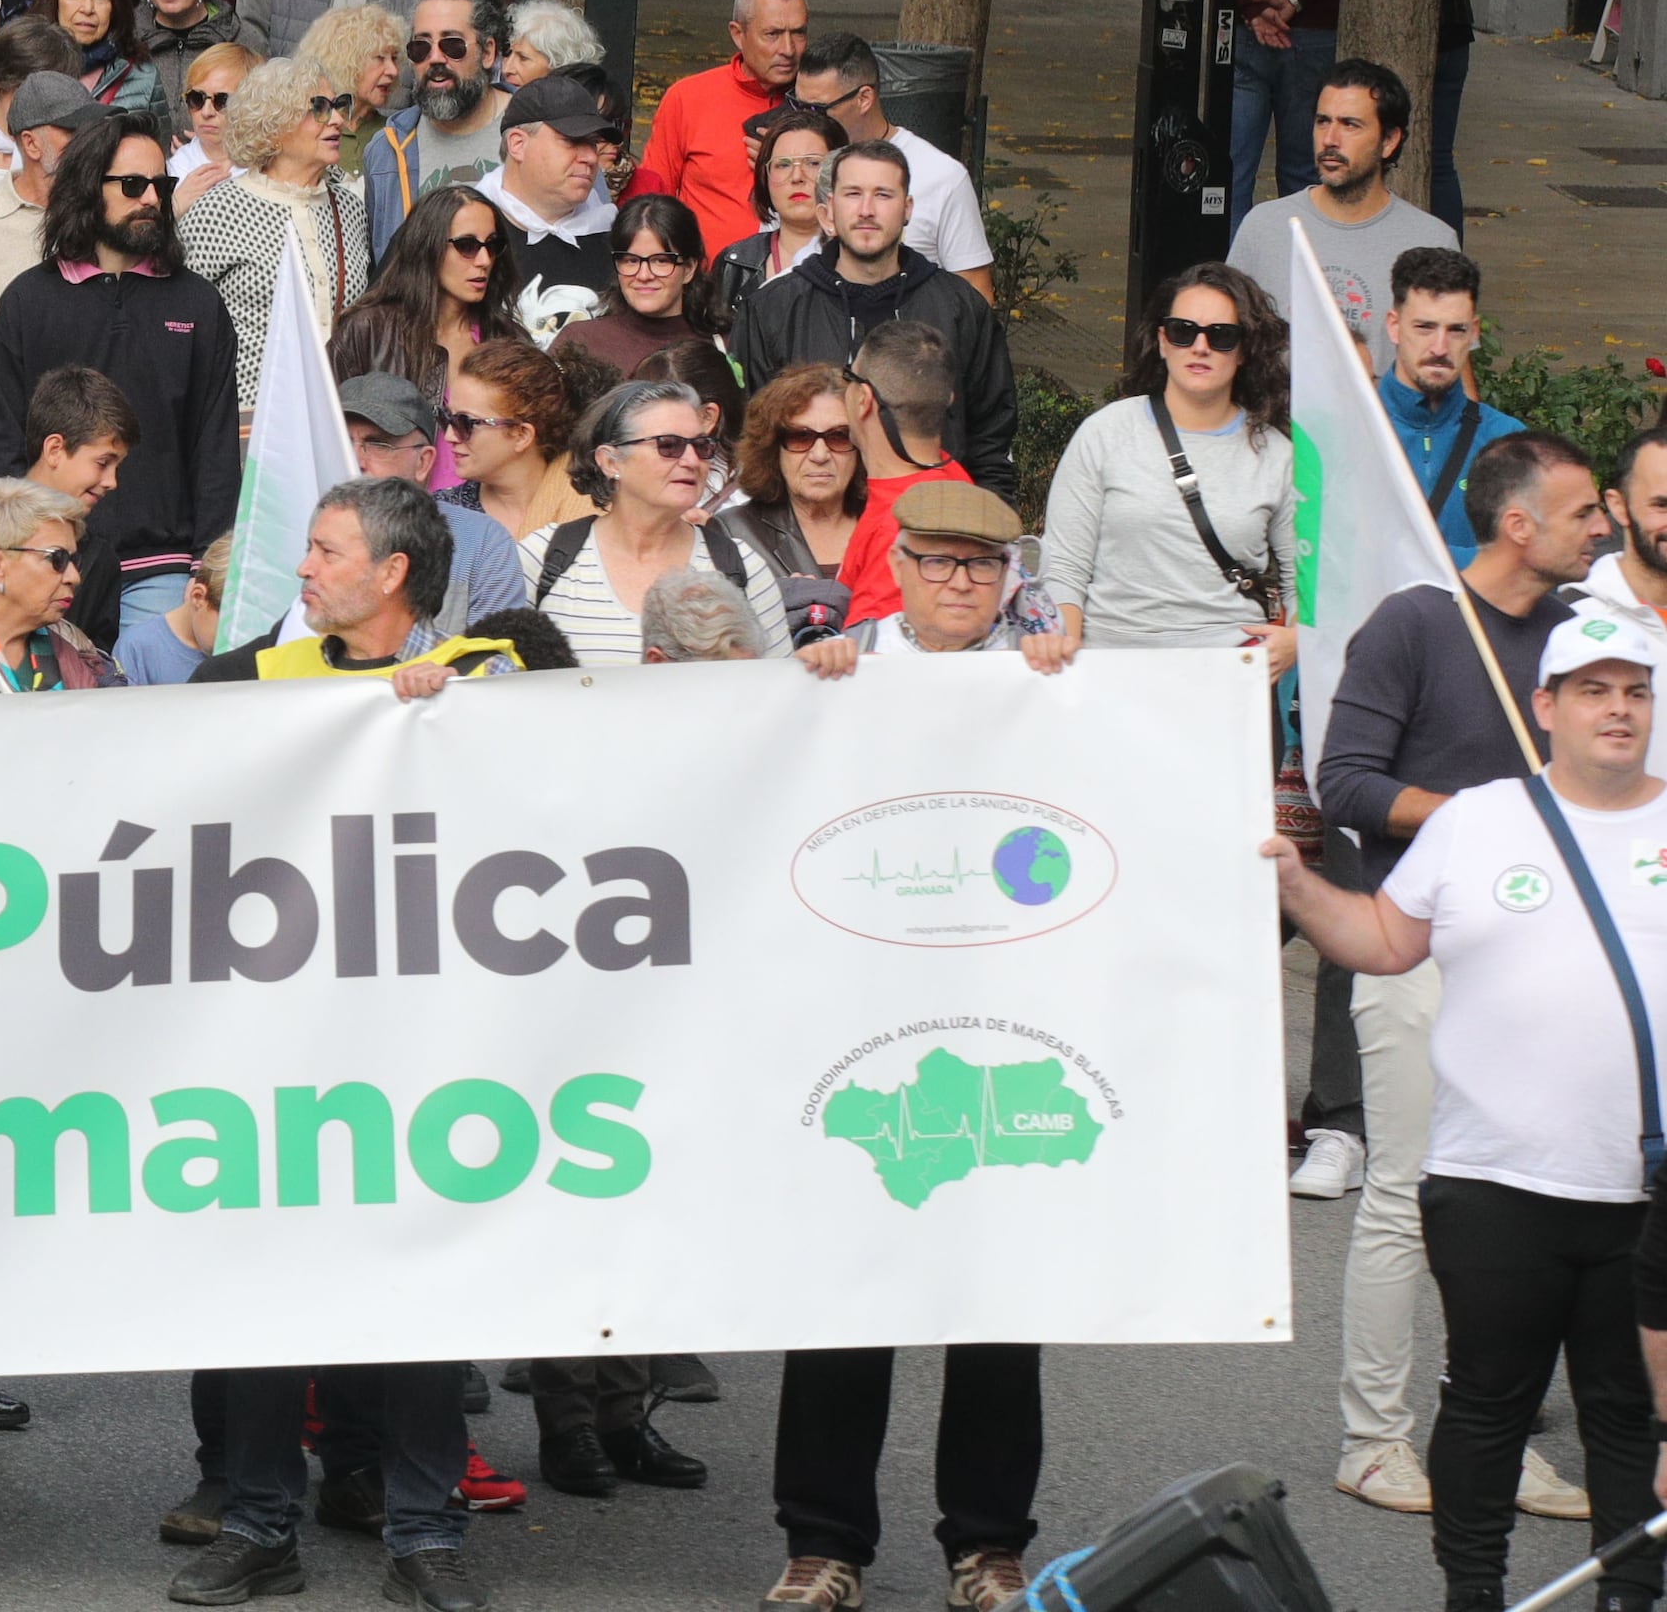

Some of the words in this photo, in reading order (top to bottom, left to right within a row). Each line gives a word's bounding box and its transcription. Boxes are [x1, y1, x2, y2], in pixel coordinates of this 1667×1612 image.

[806, 825, 842, 853] MESA
[843, 814, 862, 831] EN
[864, 800, 926, 823] DEFENSA
[928, 798, 948, 810] DE
[950, 796, 967, 809] LA
[970, 796, 1029, 815] SANIDAD
[896, 884, 955, 897] GRANADA
[800, 1031, 895, 1128] COORDINADORA
[897, 1016, 982, 1040] ANDALUZA
[985, 1017, 1007, 1033] DE
[1010, 1022, 1076, 1059] MAREAS
[1073, 1054, 1125, 1121] BLANCAS
[1013, 1113, 1075, 1132] CAMB
